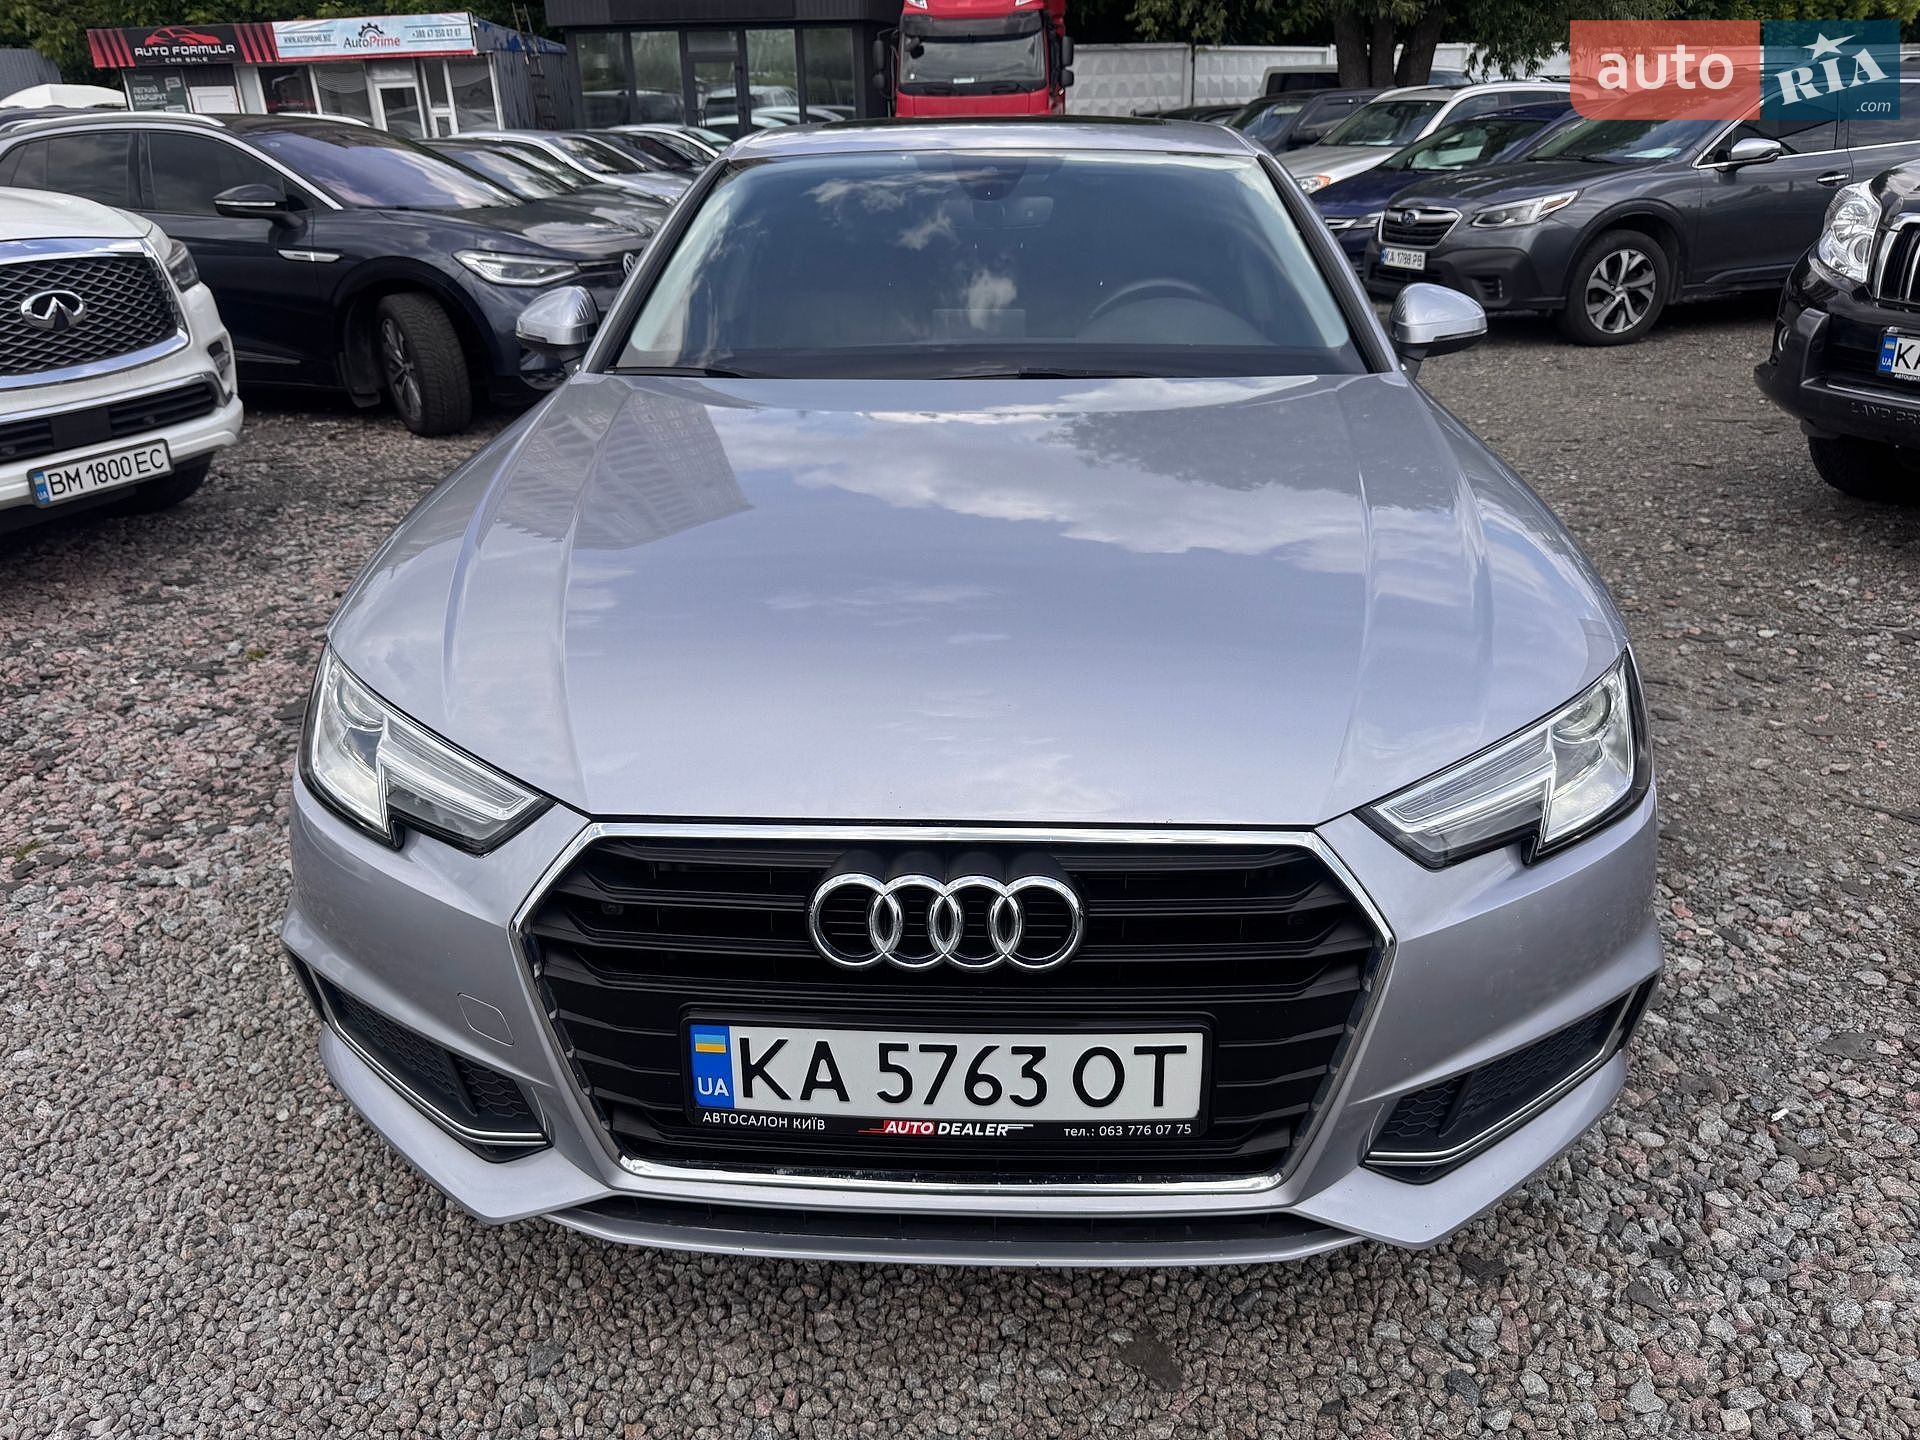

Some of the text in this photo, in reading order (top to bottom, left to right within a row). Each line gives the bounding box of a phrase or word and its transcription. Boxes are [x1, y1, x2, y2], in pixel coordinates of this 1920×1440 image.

[134, 44, 236, 57] AUTO FORMULA
[343, 35, 400, 49] AutoPrime
[1881, 356, 1892, 367] UA
[48, 449, 164, 496] BM 1800 EC
[739, 1037, 1188, 1108] KA 5763 OT
[697, 1077, 729, 1097] UA
[702, 1111, 826, 1131] АВТОСАЛОН КИЇВ
[884, 1120, 1009, 1137] AUTO DEALER
[1063, 1123, 1192, 1138] тел.: 063 776 07 75
